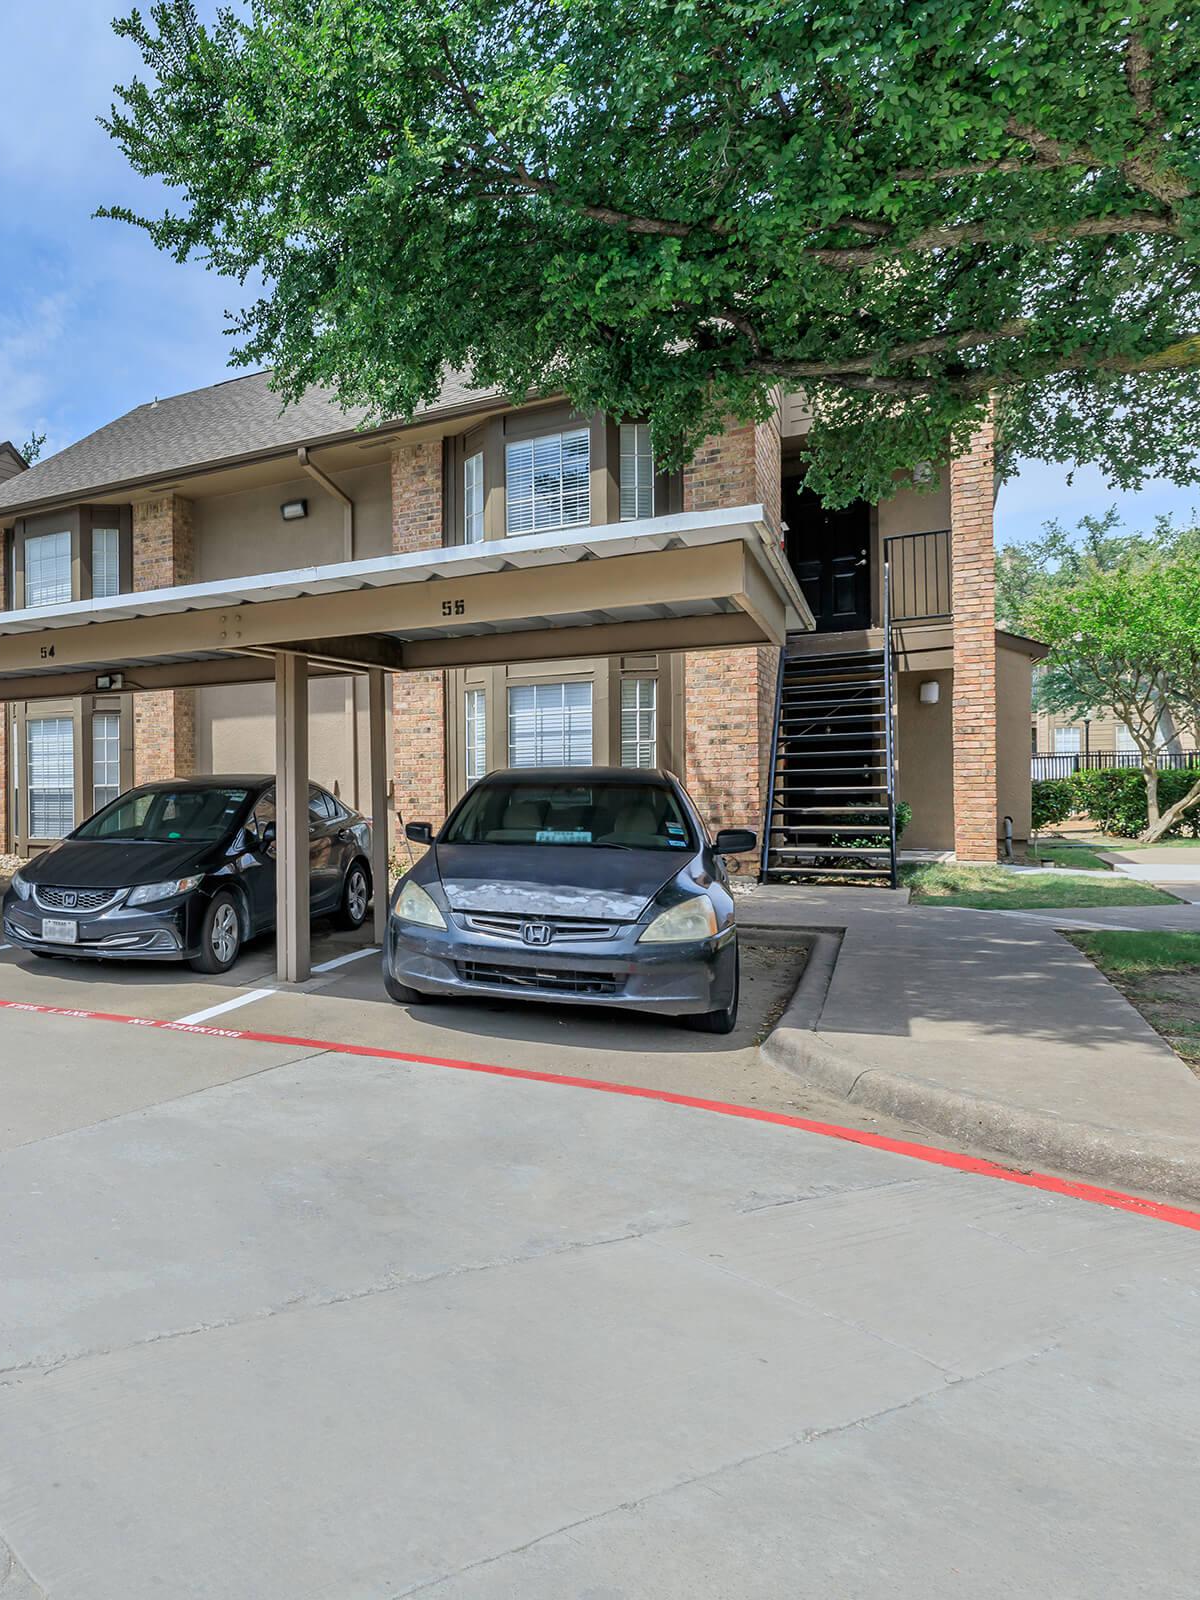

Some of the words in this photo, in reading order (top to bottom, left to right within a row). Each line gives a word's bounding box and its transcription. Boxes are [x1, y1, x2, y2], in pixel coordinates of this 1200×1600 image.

[40, 644, 55, 659] 54
[5, 1002, 45, 1012] FIRE
[47, 1008, 95, 1018] LANE
[127, 1018, 156, 1026] NO
[160, 1022, 243, 1038] PARKING
